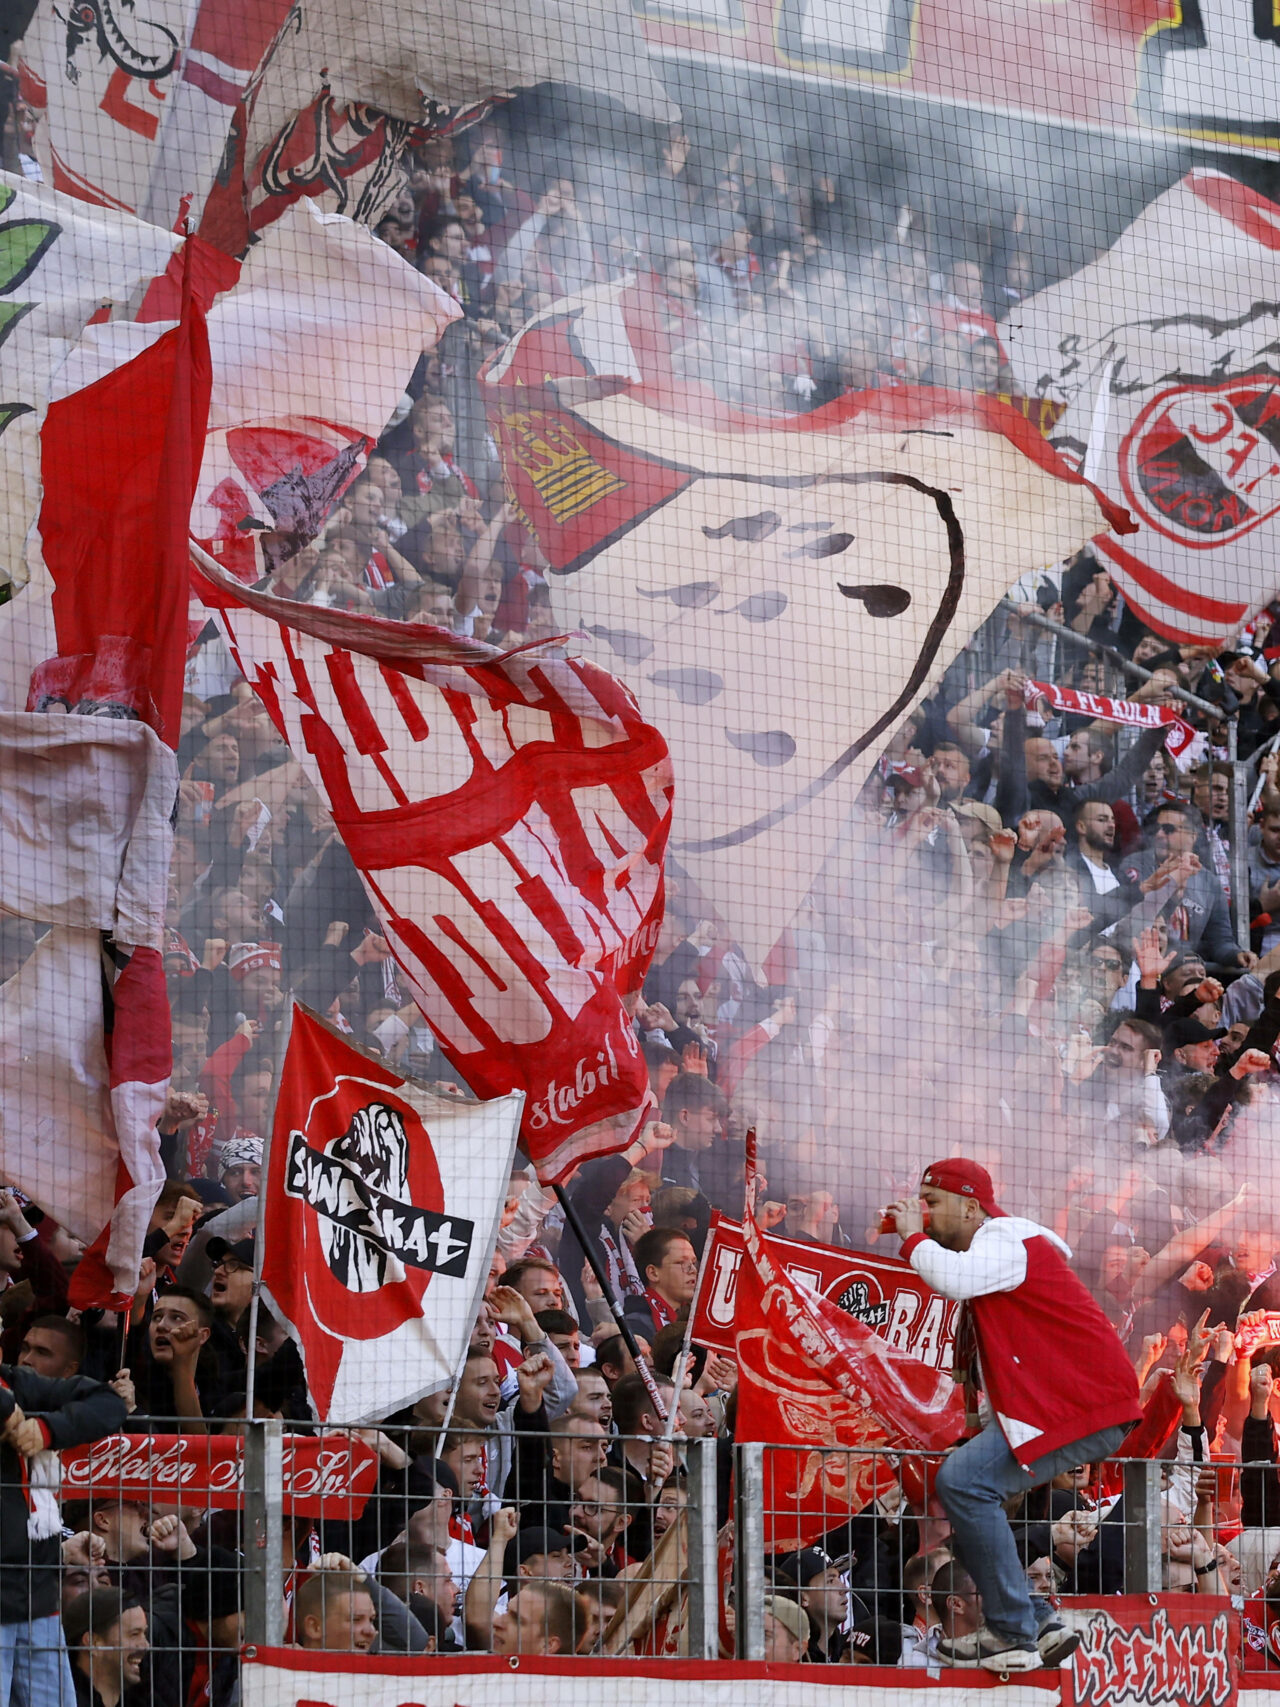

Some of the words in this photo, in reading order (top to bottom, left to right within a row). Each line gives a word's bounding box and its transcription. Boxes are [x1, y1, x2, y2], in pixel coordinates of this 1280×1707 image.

[1076, 690, 1104, 713] FC
[529, 1031, 621, 1130] stabil
[69, 1435, 197, 1485] Bleiben
